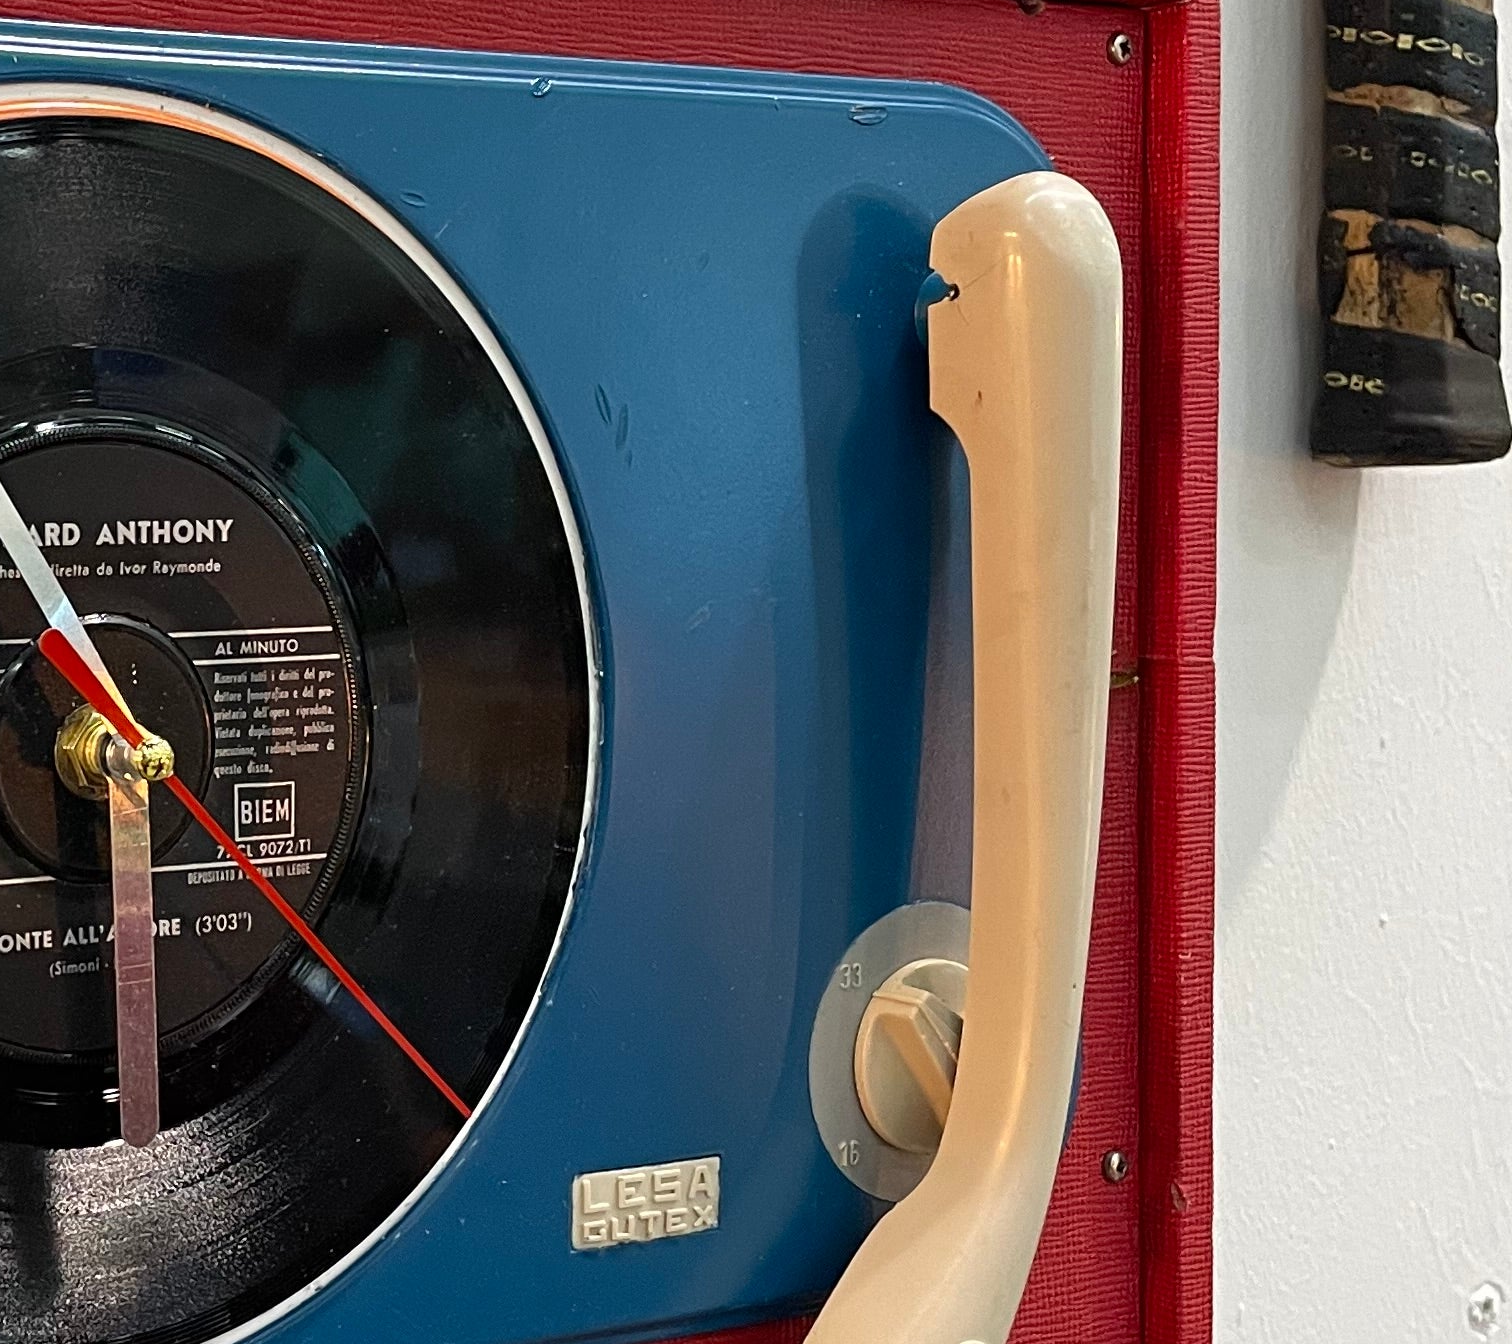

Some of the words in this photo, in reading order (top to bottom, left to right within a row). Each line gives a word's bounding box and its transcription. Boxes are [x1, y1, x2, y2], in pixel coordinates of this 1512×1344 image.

[96, 519, 234, 546] ANTHONY
[96, 562, 113, 576] da
[120, 560, 147, 577] Ivor
[152, 558, 222, 577] Raymonde
[214, 641, 233, 656] AL
[239, 638, 299, 654] MINUTO
[303, 666, 316, 681] del
[318, 670, 335, 683] pro-
[292, 688, 299, 699] e
[302, 685, 315, 699] del
[318, 688, 335, 701] pro-
[213, 763, 242, 779] questo
[240, 798, 290, 825] BIEM
[275, 865, 285, 876] DI
[49, 958, 101, 978] (Simoni
[839, 963, 862, 989] 33
[838, 1140, 860, 1167] 16
[582, 1165, 714, 1214] LESA
[583, 1205, 714, 1243] GUTEX
